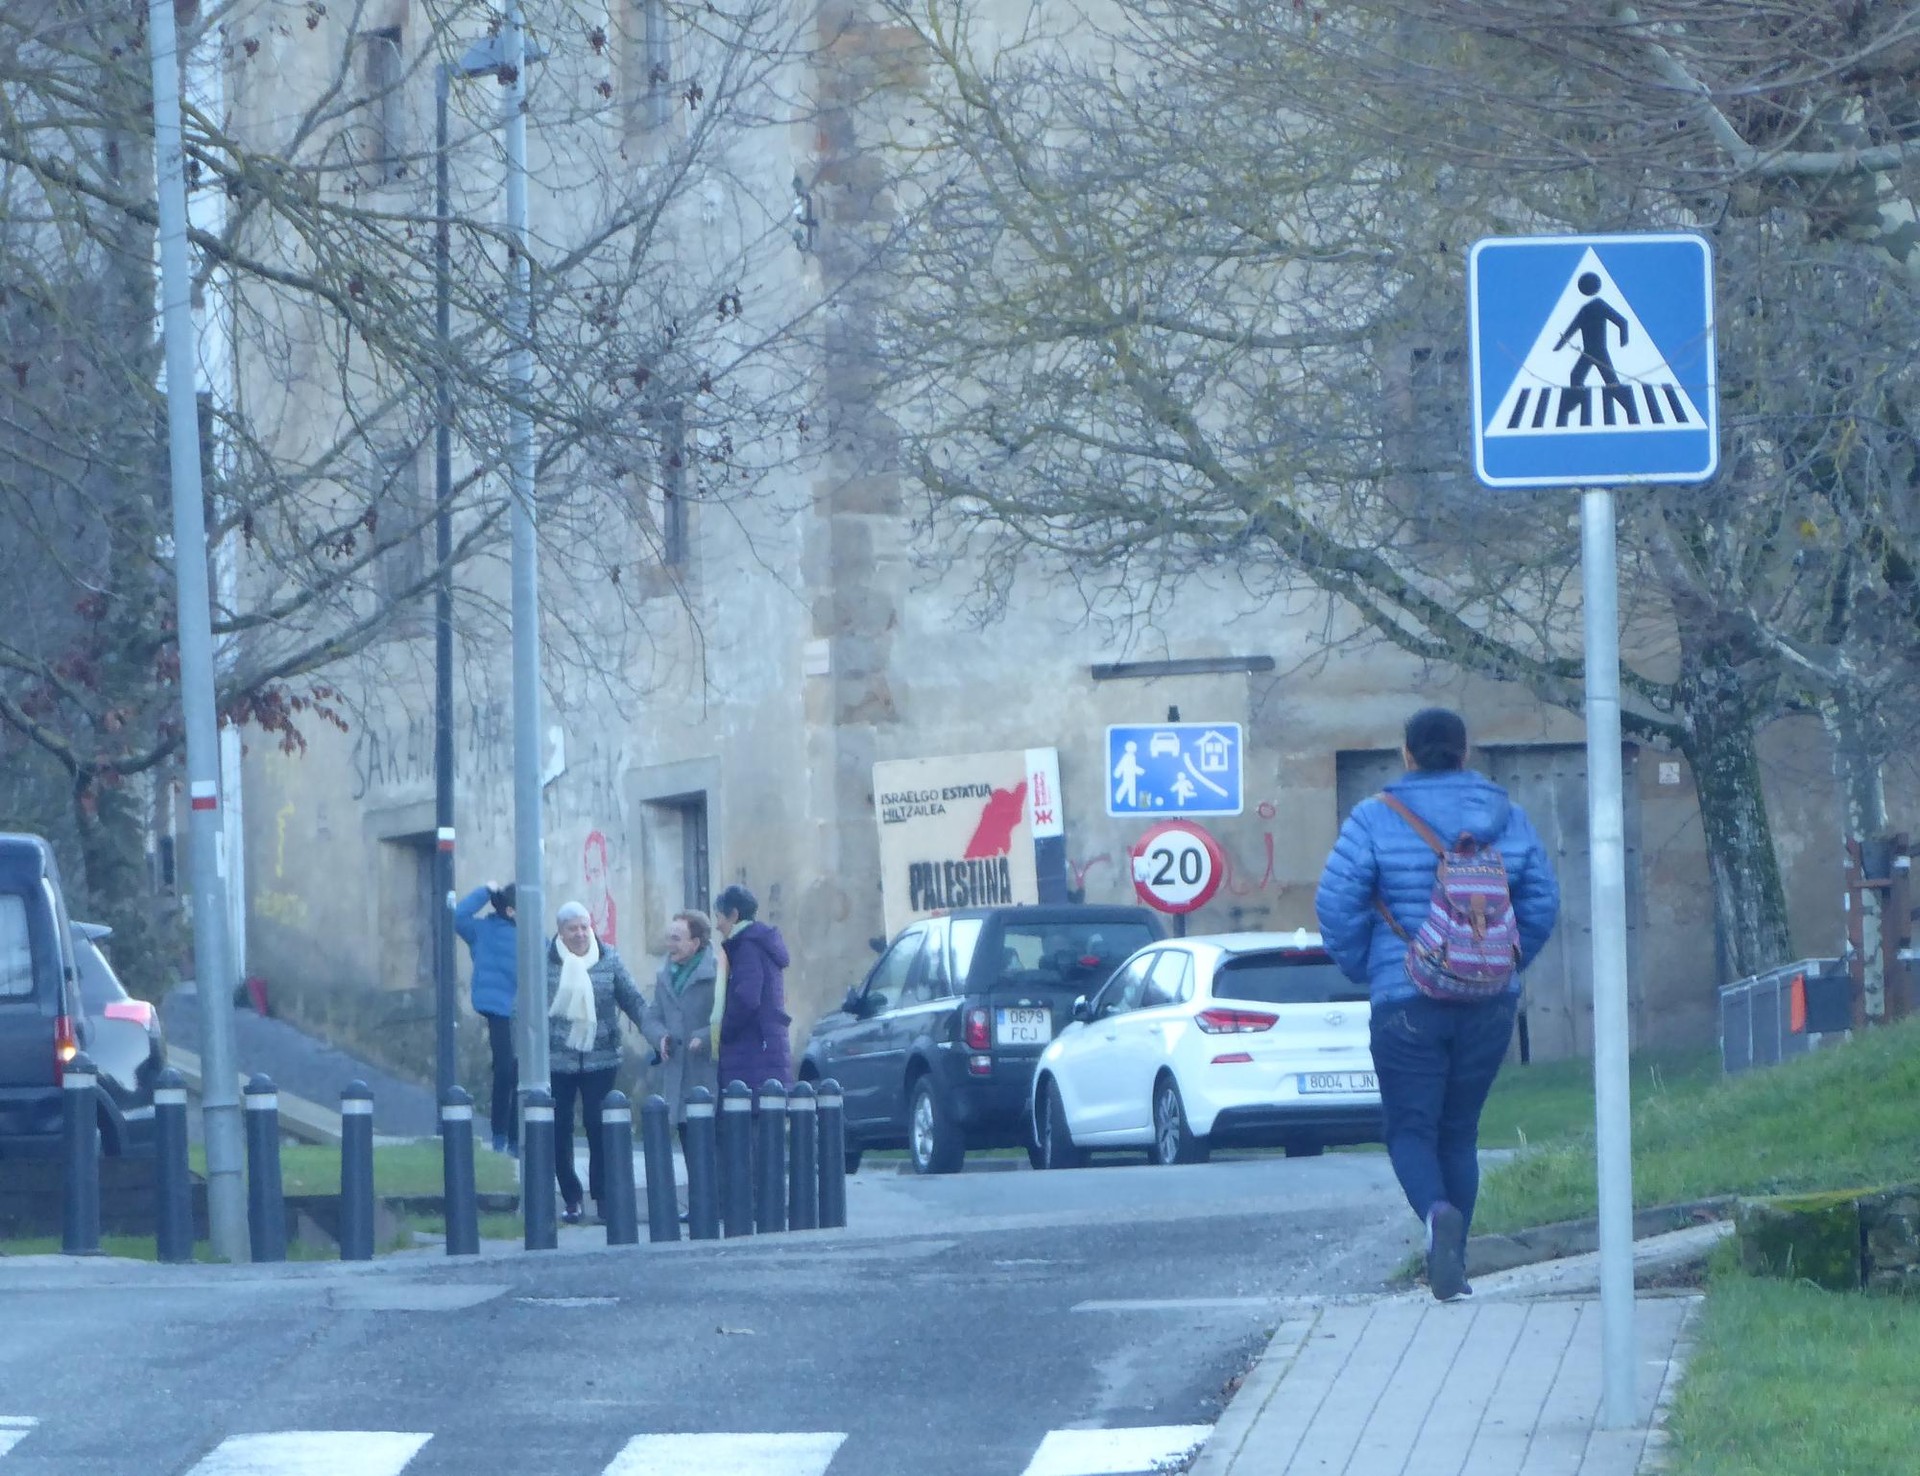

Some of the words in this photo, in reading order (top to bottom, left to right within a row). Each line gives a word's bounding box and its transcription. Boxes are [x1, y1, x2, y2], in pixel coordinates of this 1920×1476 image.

[880, 789, 939, 805] ISRAELGO
[942, 783, 992, 801] ESTATUA
[882, 803, 946, 820] HILTZAILEA
[1151, 848, 1203, 886] 20
[909, 856, 1012, 912] PALESTINA
[1010, 1008, 1044, 1024] 0679
[1011, 1027, 1038, 1040] FCJ
[1310, 1074, 1343, 1089] 8004
[1349, 1074, 1375, 1088] LJN
